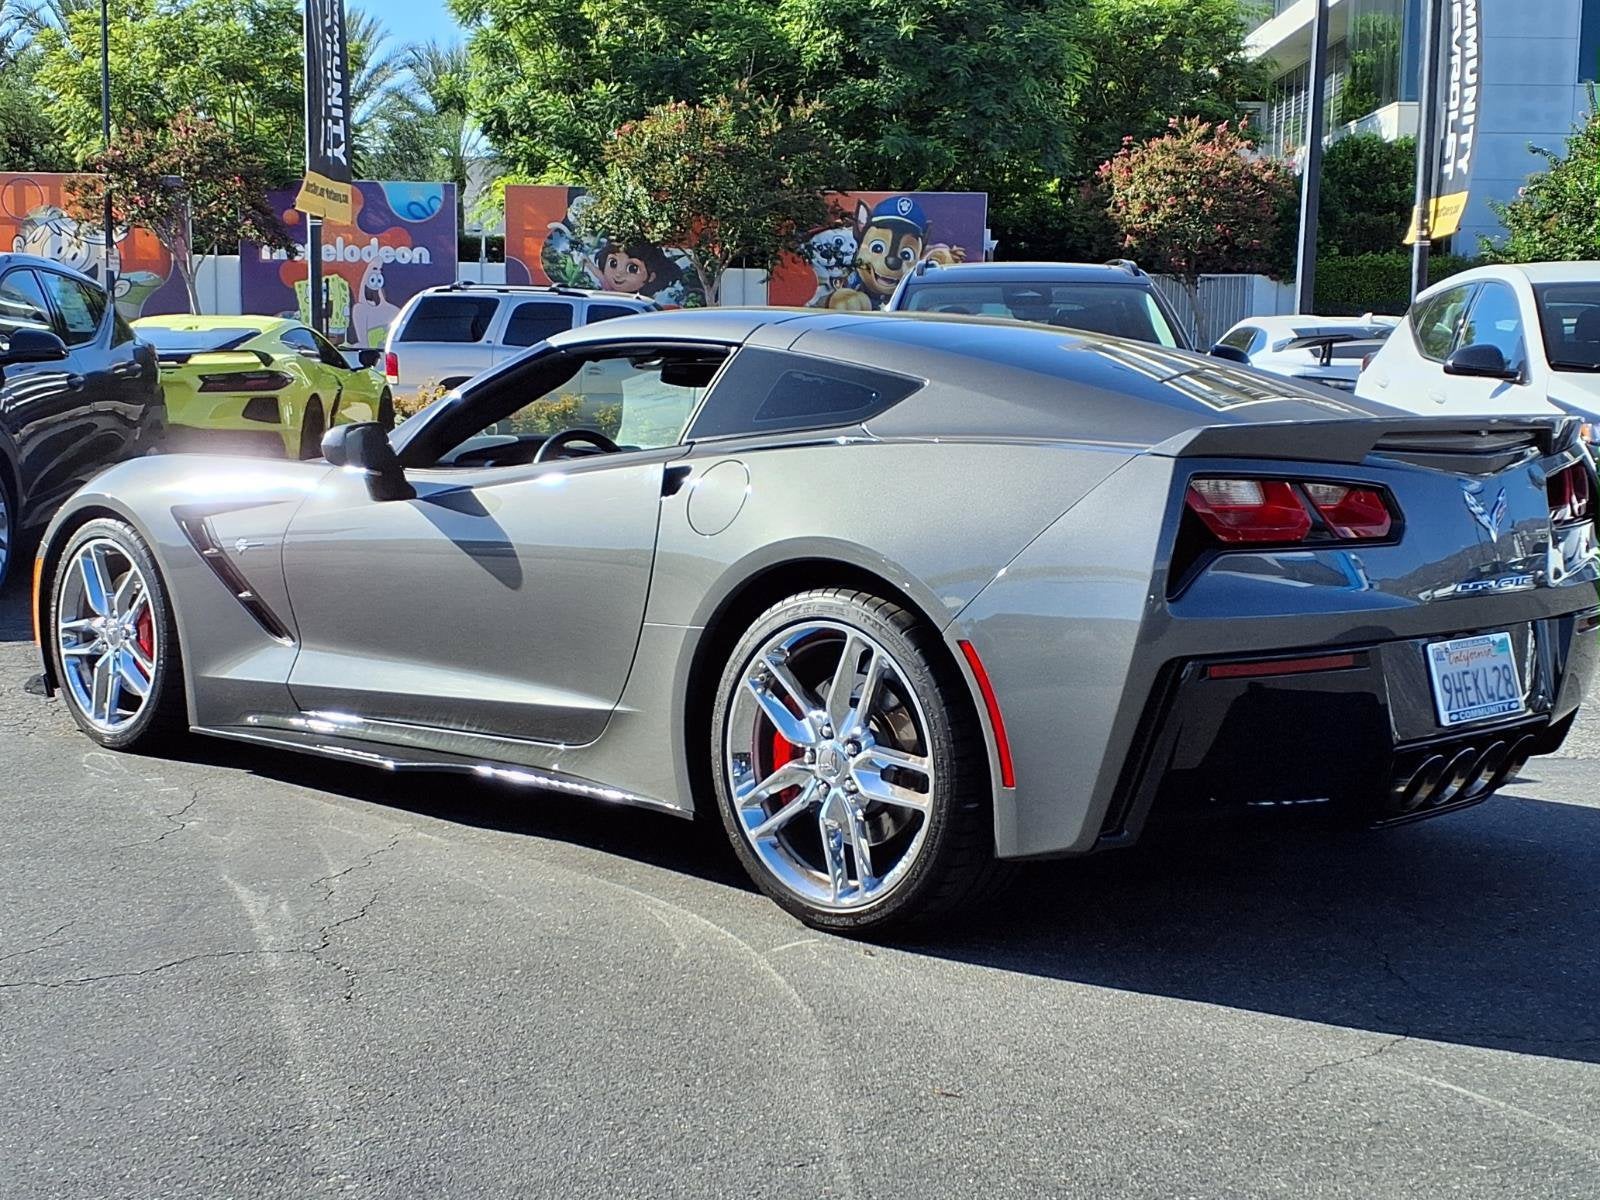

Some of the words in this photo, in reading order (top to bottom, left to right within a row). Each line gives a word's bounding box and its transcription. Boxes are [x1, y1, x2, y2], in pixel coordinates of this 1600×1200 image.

[261, 237, 431, 264] nicelodeon
[1449, 647, 1497, 667] California
[1441, 664, 1515, 711] 9HEK428
[1460, 702, 1510, 720] COMMUNITY
